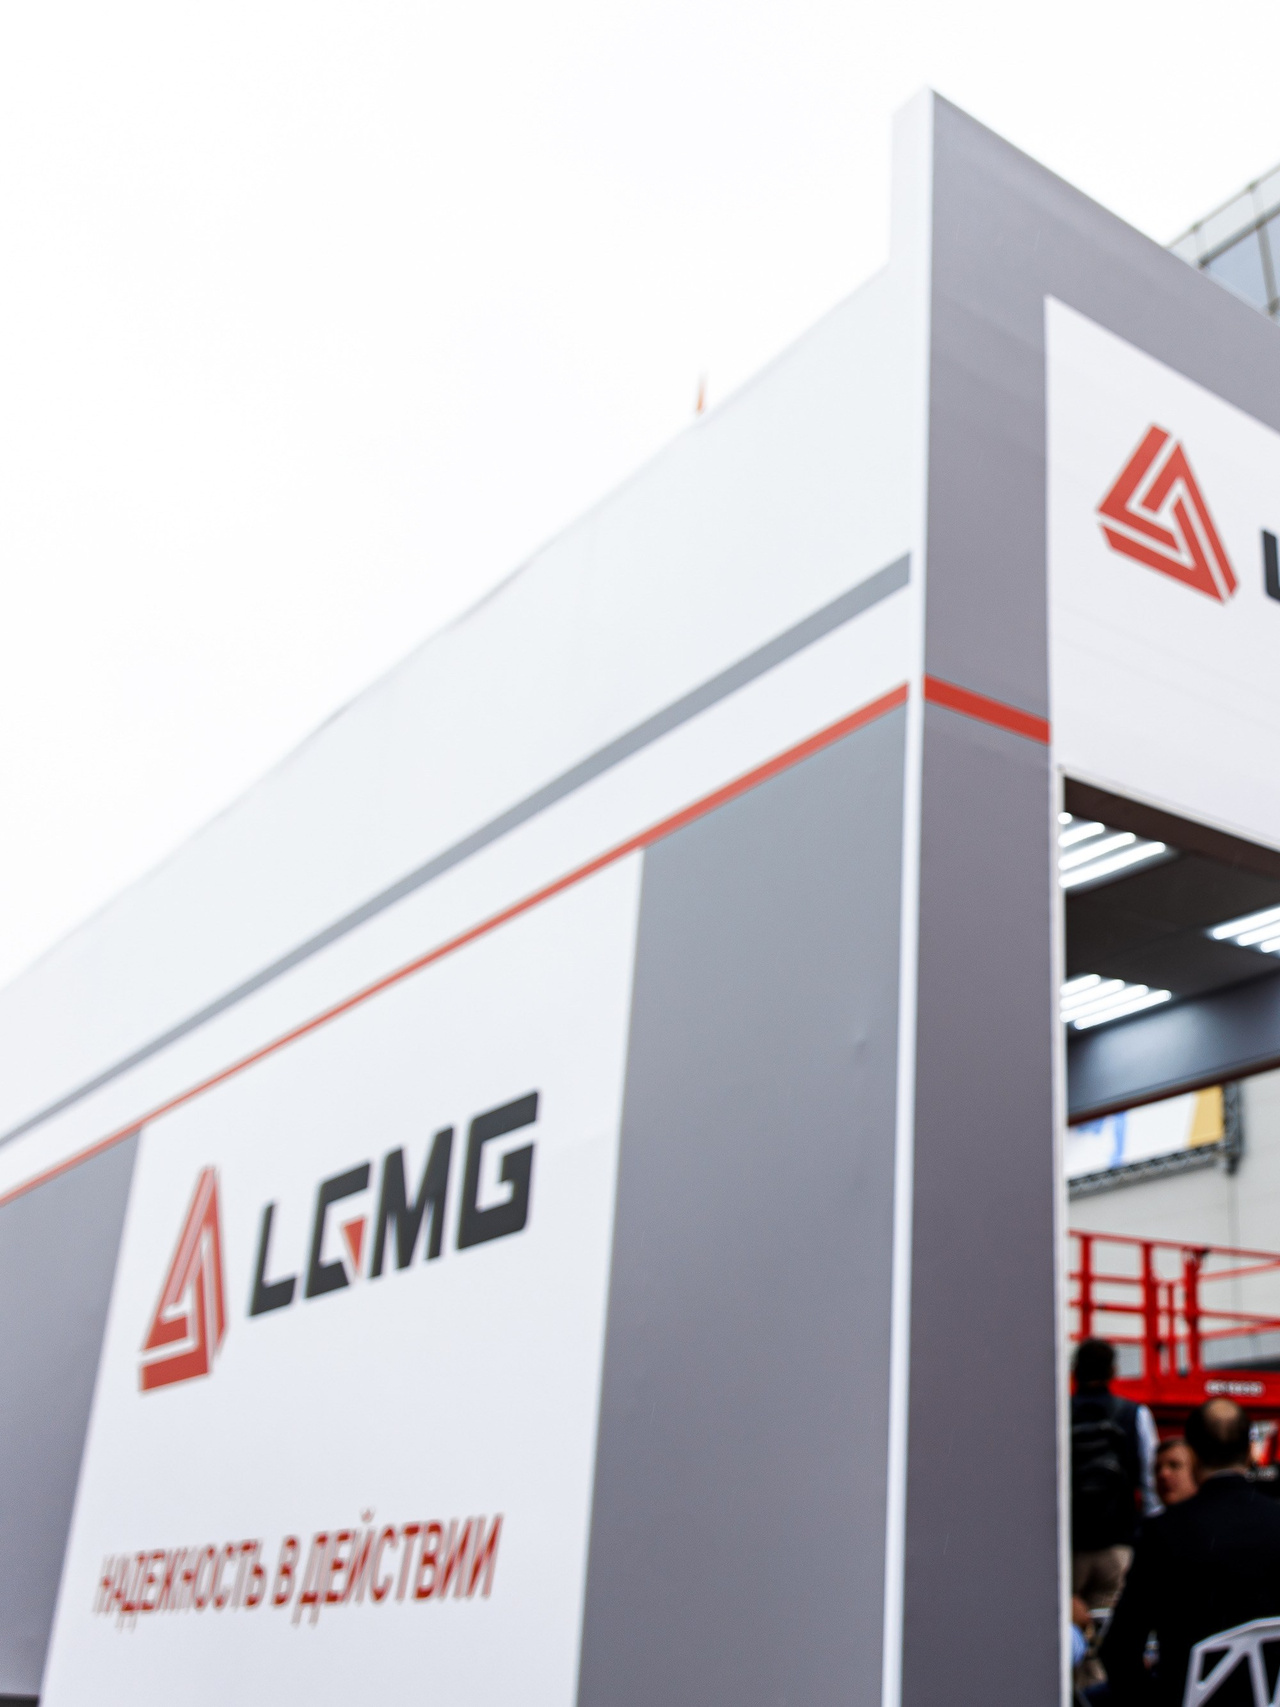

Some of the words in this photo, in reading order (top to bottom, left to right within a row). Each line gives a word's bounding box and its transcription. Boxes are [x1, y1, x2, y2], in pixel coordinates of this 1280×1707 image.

[248, 1088, 540, 1318] LGMG
[94, 1536, 267, 1631] НАДЕЖНОСТЬ
[272, 1534, 300, 1608] В
[291, 1507, 504, 1627] ДЕЙСТВИИ
